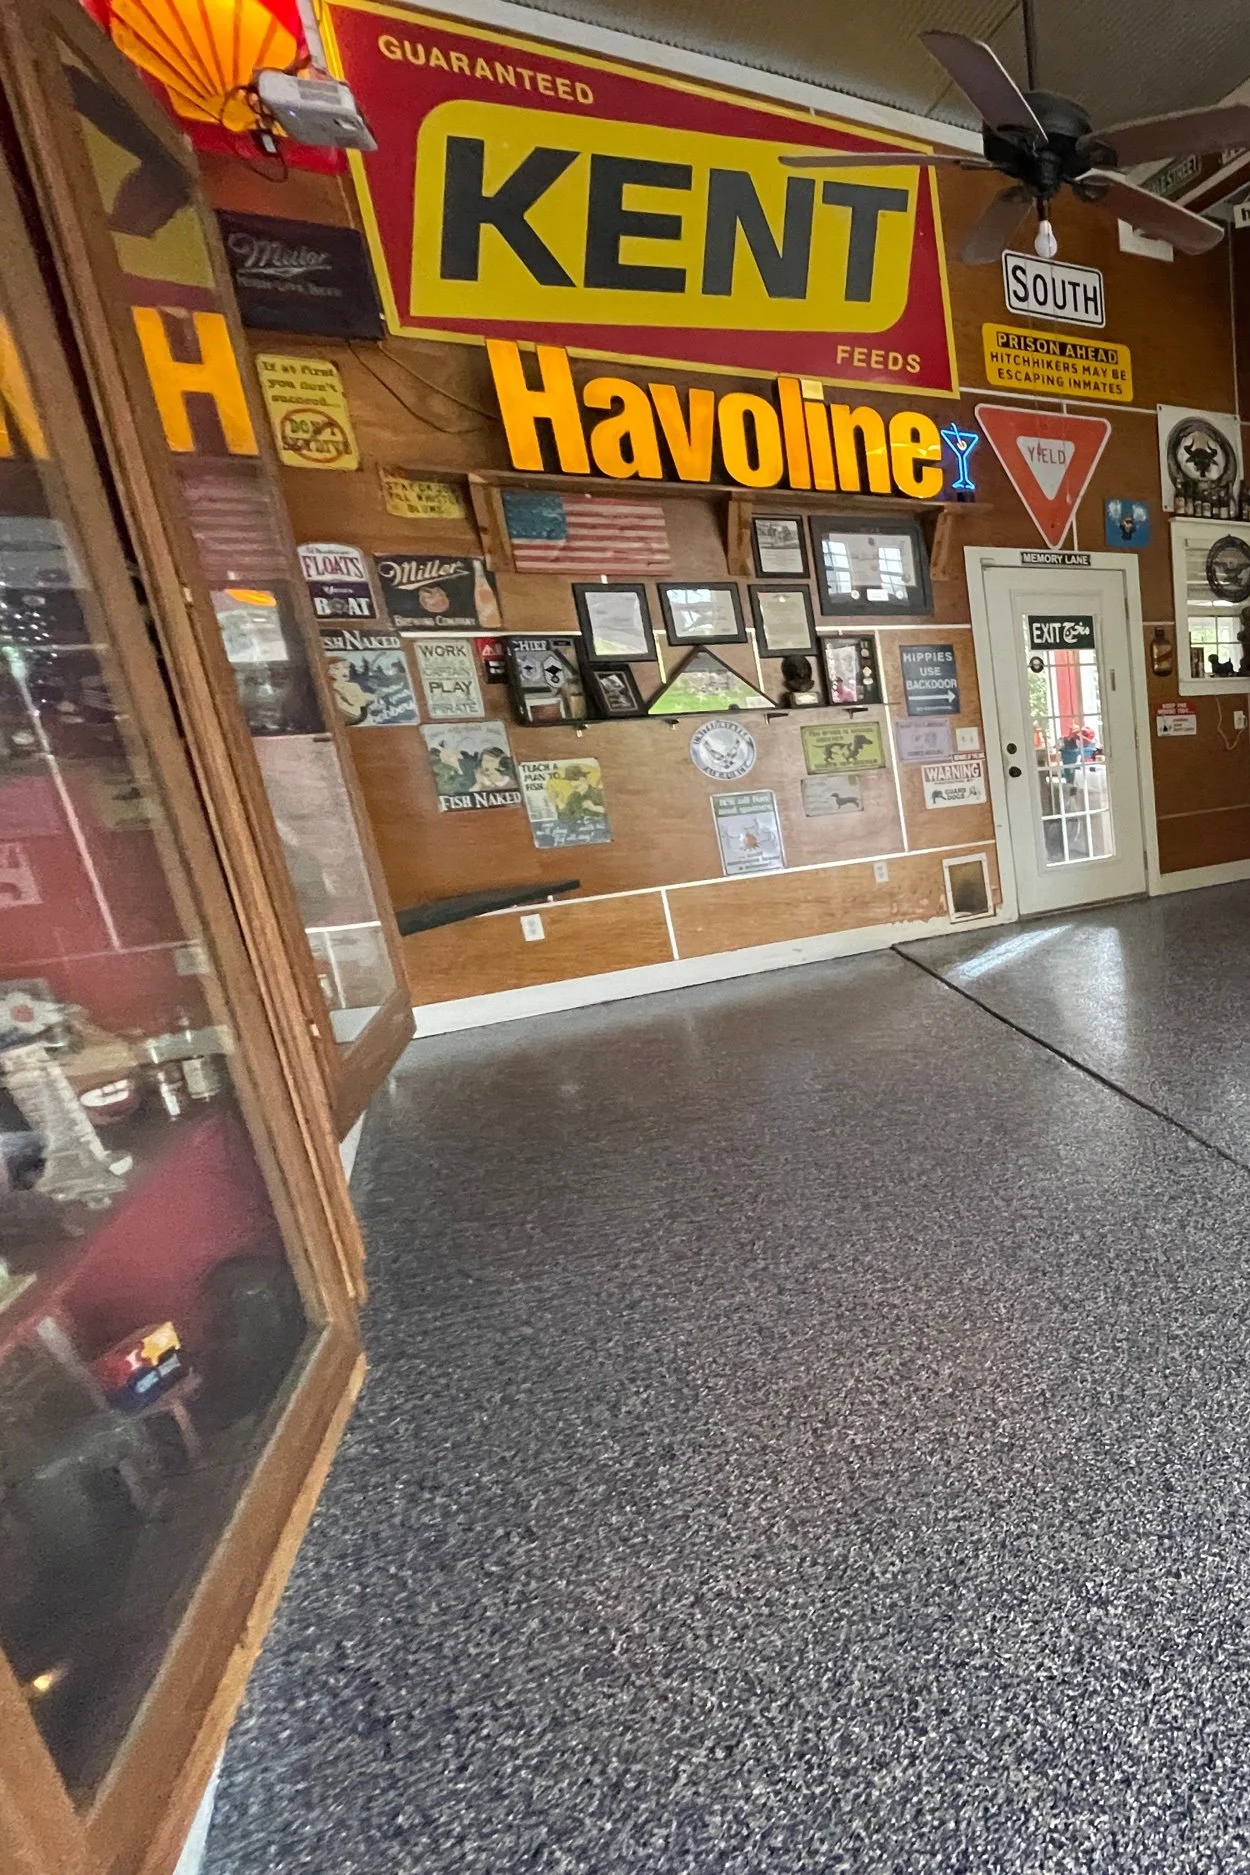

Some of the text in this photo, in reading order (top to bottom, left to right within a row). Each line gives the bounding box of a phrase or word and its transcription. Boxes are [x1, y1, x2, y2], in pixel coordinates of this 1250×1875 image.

[378, 34, 594, 106] GUARANTEED
[441, 135, 910, 302] KENT
[1012, 264, 1100, 318] SOUTH
[998, 332, 1117, 364] PRISON AHEAD
[836, 344, 921, 375] FEEDS
[991, 352, 1126, 381] HITCHHIKERS MAY BE
[998, 368, 1122, 395] ESCAPING INMATES
[485, 338, 943, 498] Havoline
[1026, 447, 1066, 464] YIELD
[302, 556, 363, 578] FLOATS
[1023, 553, 1089, 565] MEMORY LANE
[379, 560, 464, 586] Miller
[1032, 622, 1061, 644] EXIT
[419, 645, 467, 658] WORK
[902, 652, 953, 663] HIPPIES
[919, 667, 942, 676] USE
[428, 681, 473, 694] PLAY
[906, 679, 957, 690] BACKDOOR
[521, 763, 549, 772] TEACH
[926, 763, 979, 781] WARNING
[524, 773, 545, 782] MAN
[945, 787, 967, 795] GUARD
[439, 795, 472, 811] FISH
[473, 792, 520, 808] NAKED
